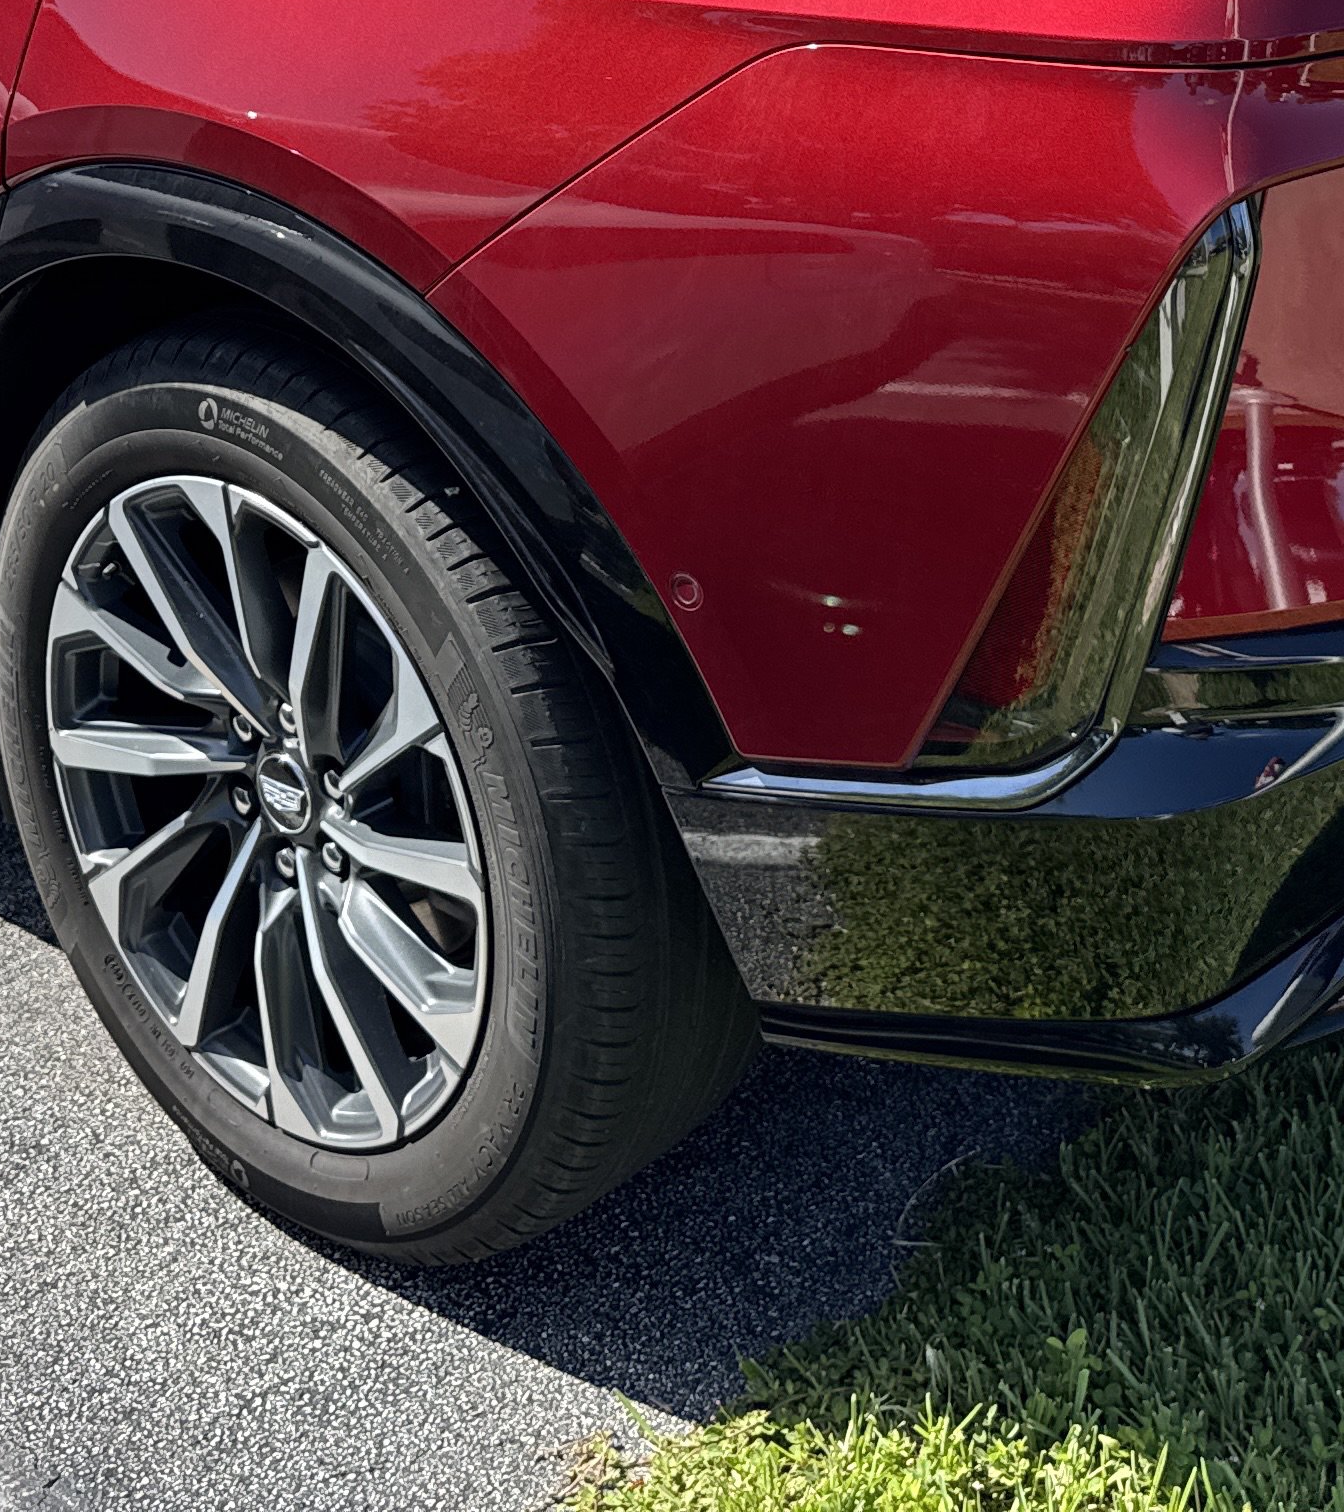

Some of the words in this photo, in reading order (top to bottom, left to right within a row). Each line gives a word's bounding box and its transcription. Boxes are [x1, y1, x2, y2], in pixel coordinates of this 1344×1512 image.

[218, 419, 236, 434] Total
[235, 426, 284, 461] Performance
[220, 407, 270, 439] MICHELIN
[482, 770, 540, 1051] MICHELIN
